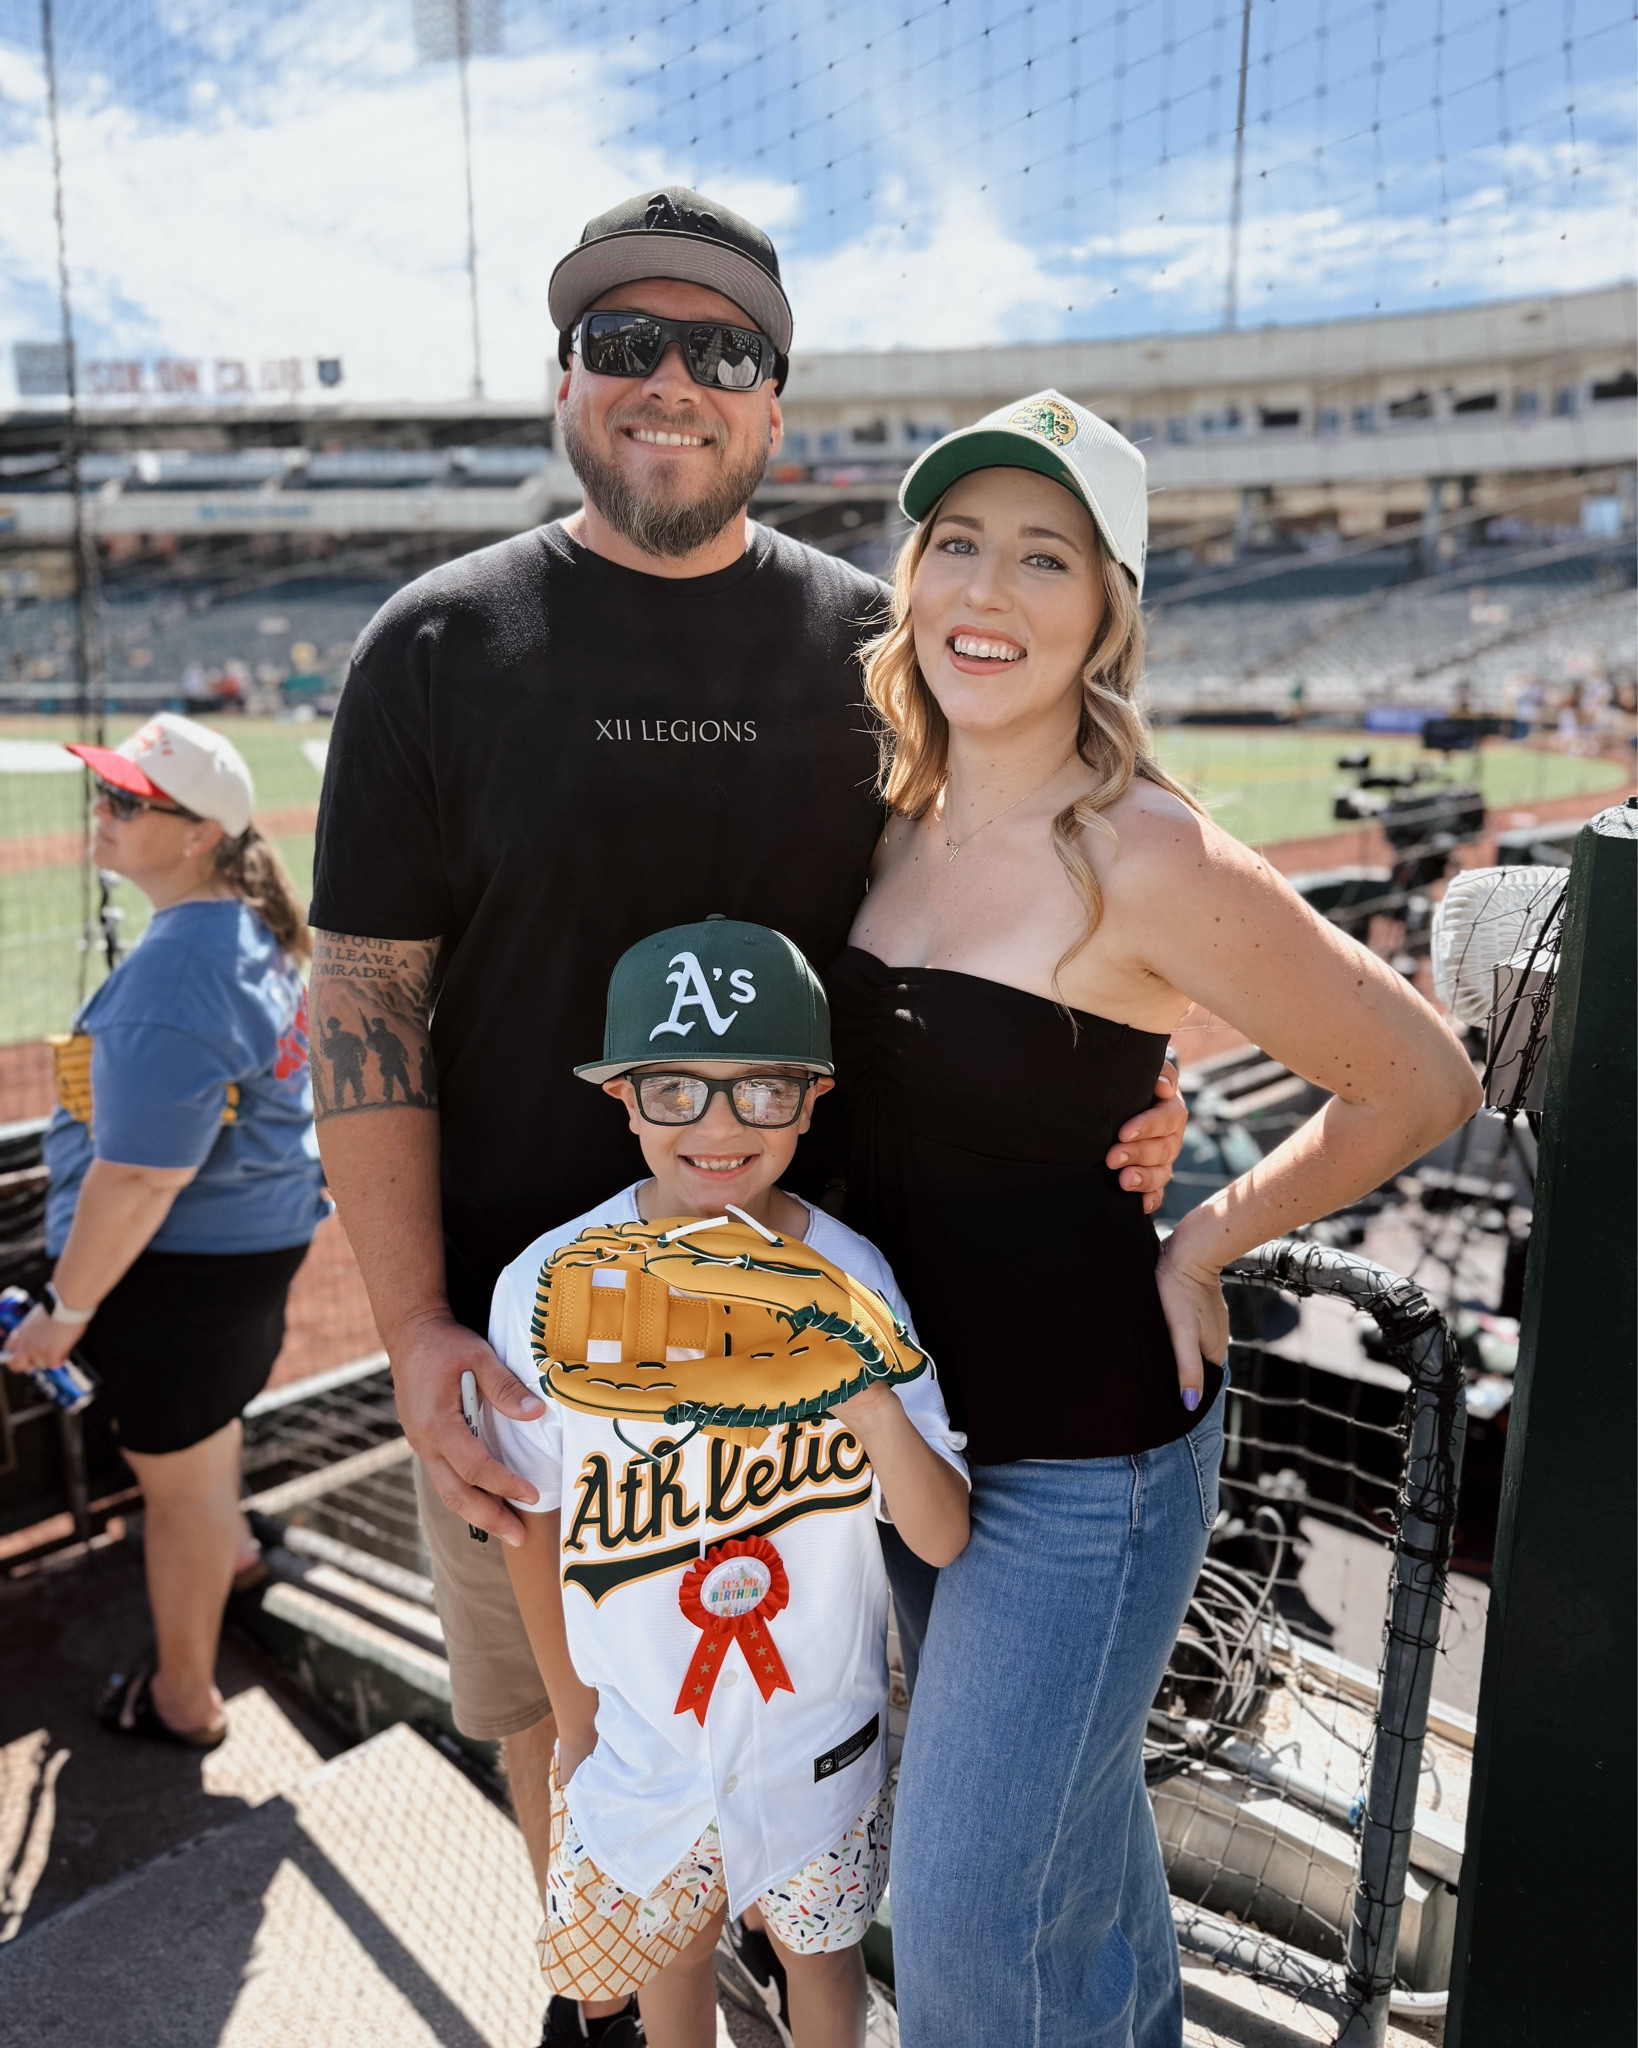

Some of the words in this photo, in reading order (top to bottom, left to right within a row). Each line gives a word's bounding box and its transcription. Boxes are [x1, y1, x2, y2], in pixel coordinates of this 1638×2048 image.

[595, 719, 631, 740] XII
[641, 720, 757, 742] LEGIONS
[336, 948, 394, 966] LEAVE
[397, 959, 410, 969] A
[649, 951, 757, 1042] A's
[562, 1418, 873, 1553] Athletic
[712, 1588, 763, 1602] BIRTHDAY
[721, 1580, 740, 1589] It's
[743, 1579, 758, 1588] My
